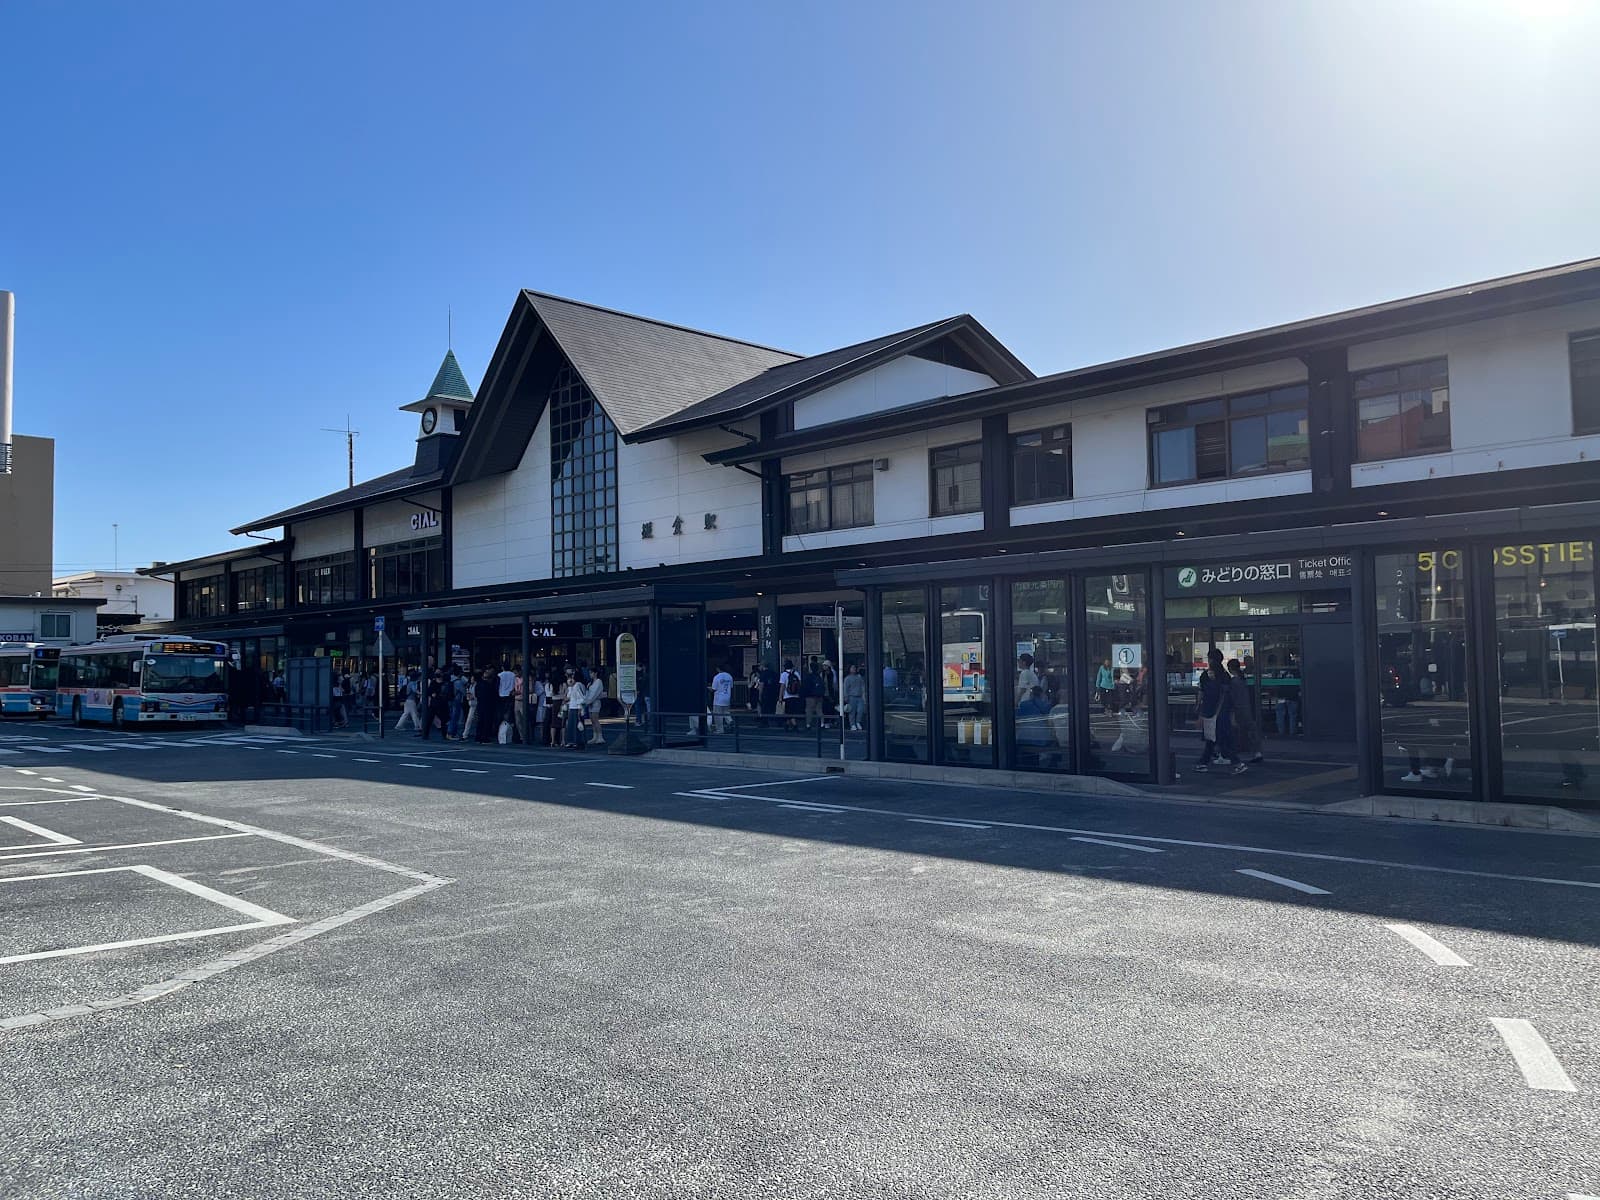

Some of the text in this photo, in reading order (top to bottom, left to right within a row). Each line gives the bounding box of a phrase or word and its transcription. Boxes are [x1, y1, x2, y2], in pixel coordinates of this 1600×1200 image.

[411, 511, 438, 530] CIAL
[1298, 556, 1352, 569] Ticket Offic
[1417, 541, 1594, 572] 5 CSSTIE
[1201, 563, 1292, 583] みどりの窓口
[0, 634, 33, 642] KOBAN
[531, 627, 557, 637] CIAL
